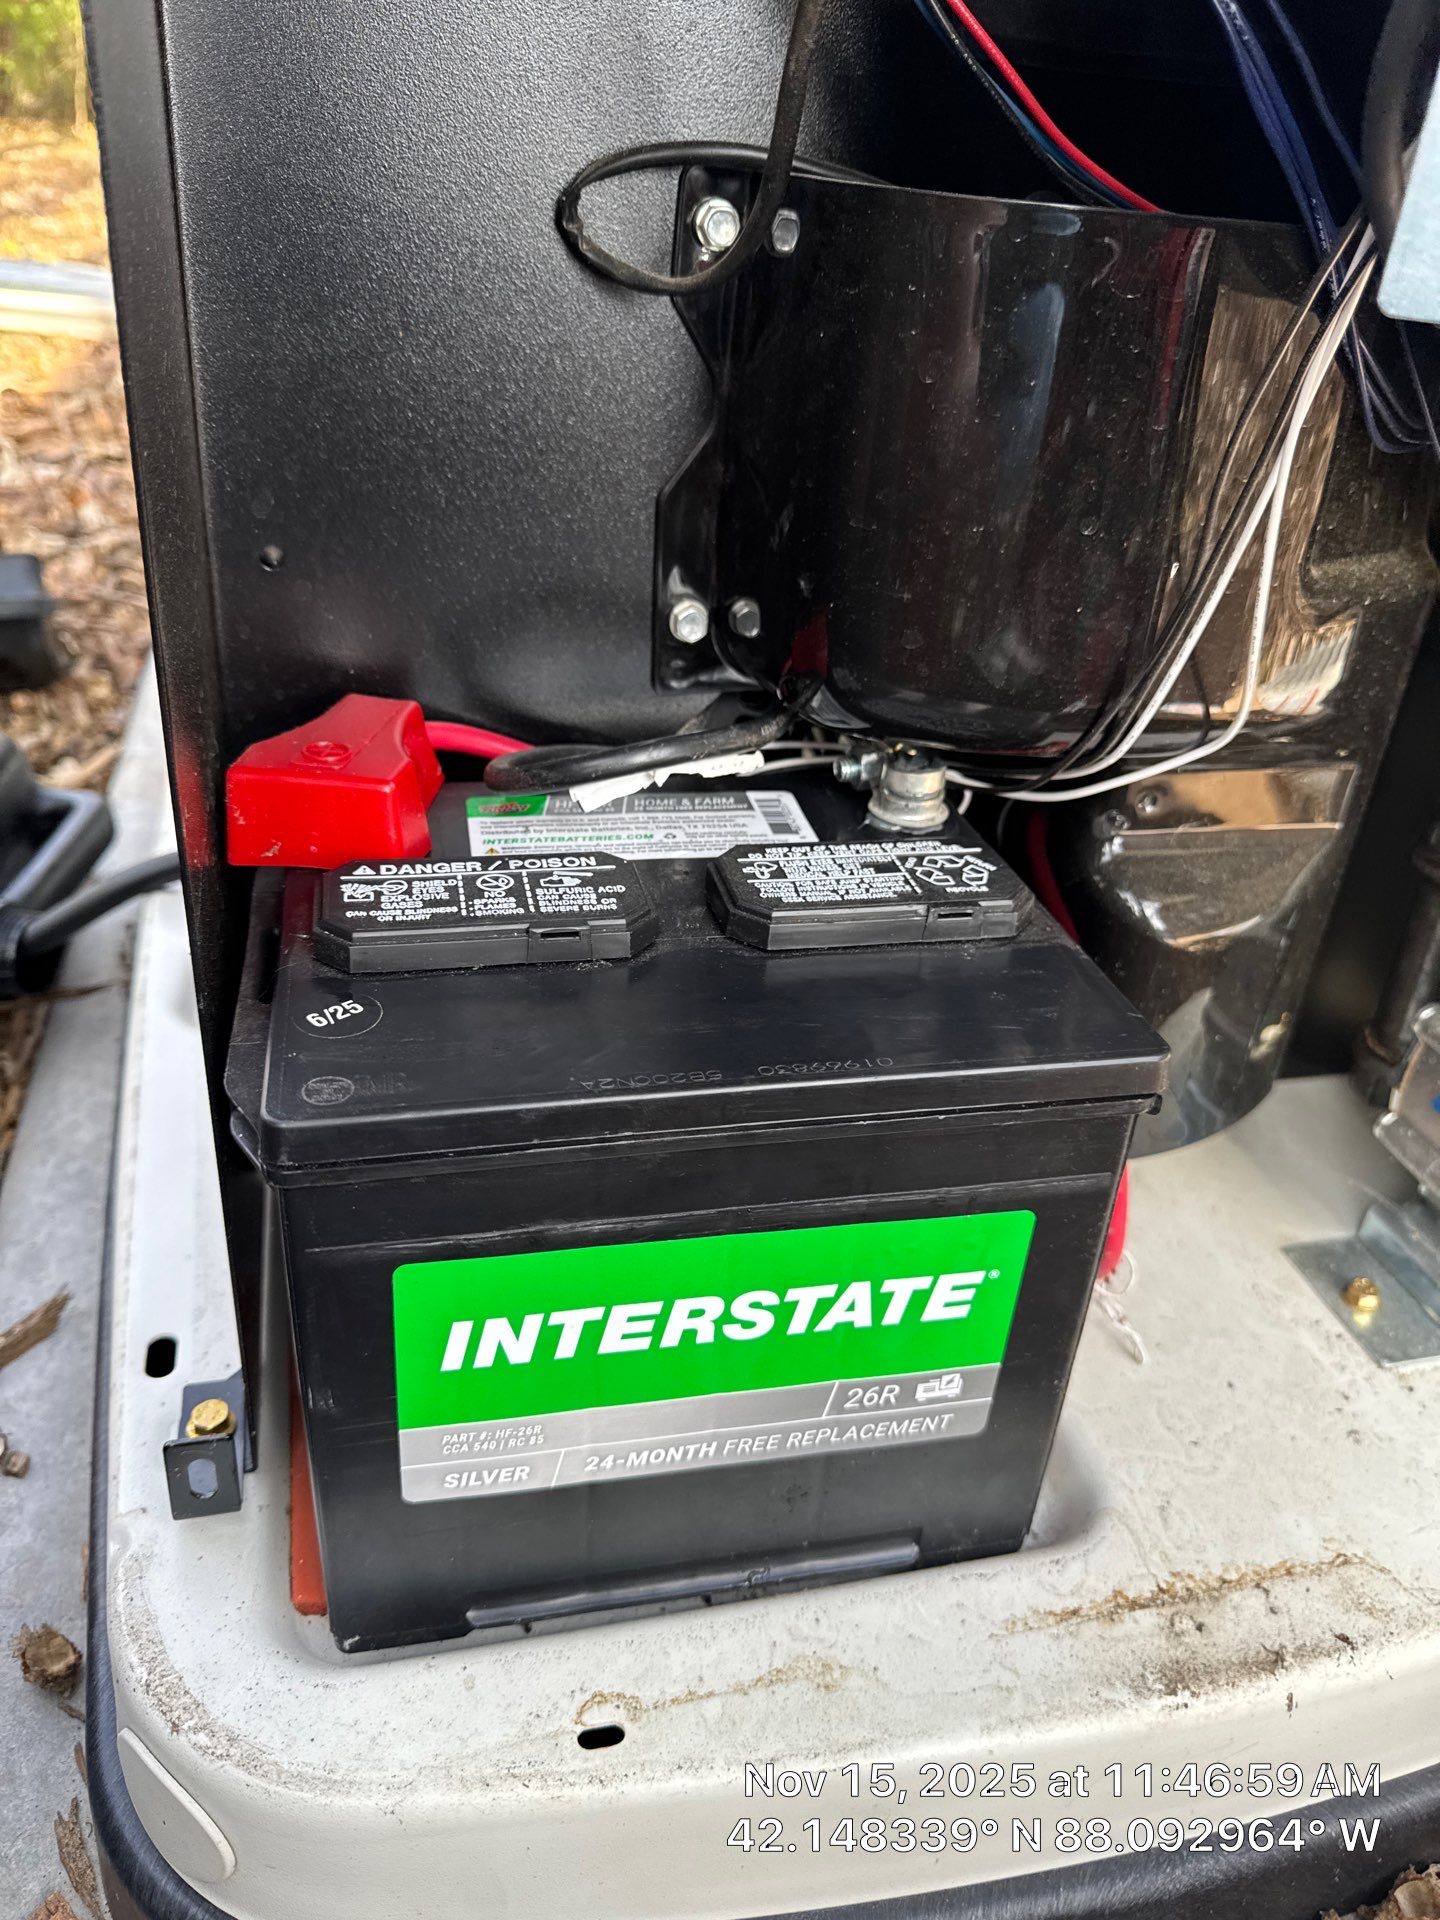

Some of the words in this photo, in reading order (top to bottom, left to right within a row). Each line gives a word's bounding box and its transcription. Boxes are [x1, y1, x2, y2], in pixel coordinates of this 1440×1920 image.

[634, 796, 677, 807] HOME
[694, 796, 735, 806] FARM
[482, 833, 655, 845] INTERSTATEBATTERIES.COM
[380, 861, 482, 875] DANGER
[488, 861, 502, 871] /
[508, 856, 597, 870] POISON
[411, 879, 457, 888] SHIELD
[412, 886, 446, 895] EYES
[483, 890, 507, 898] NO
[535, 886, 595, 895] SULFURIC
[598, 885, 626, 893] ACID
[380, 892, 450, 903] EXPLOSIVE
[539, 899, 598, 907] BLINDNESS
[381, 901, 423, 910] GASES
[540, 905, 580, 913] SEVERE
[345, 910, 368, 918] CAN
[369, 909, 403, 917] CAUSE
[404, 906, 459, 916] BLINDNESS
[395, 914, 431, 922] INJURY
[305, 999, 364, 1027] 6/25
[843, 1384, 901, 1409] 26R
[441, 1433, 480, 1446] PART
[494, 1424, 544, 1440] HF-26R
[442, 1443, 469, 1455] CCA
[473, 1440, 497, 1452] 540
[507, 1437, 526, 1449] RC
[528, 1435, 545, 1446] 85
[584, 1441, 717, 1474] 24-MONTH
[722, 1433, 783, 1455] FREE
[786, 1412, 955, 1449] REPLACEMENT
[443, 1465, 531, 1490] SILVER
